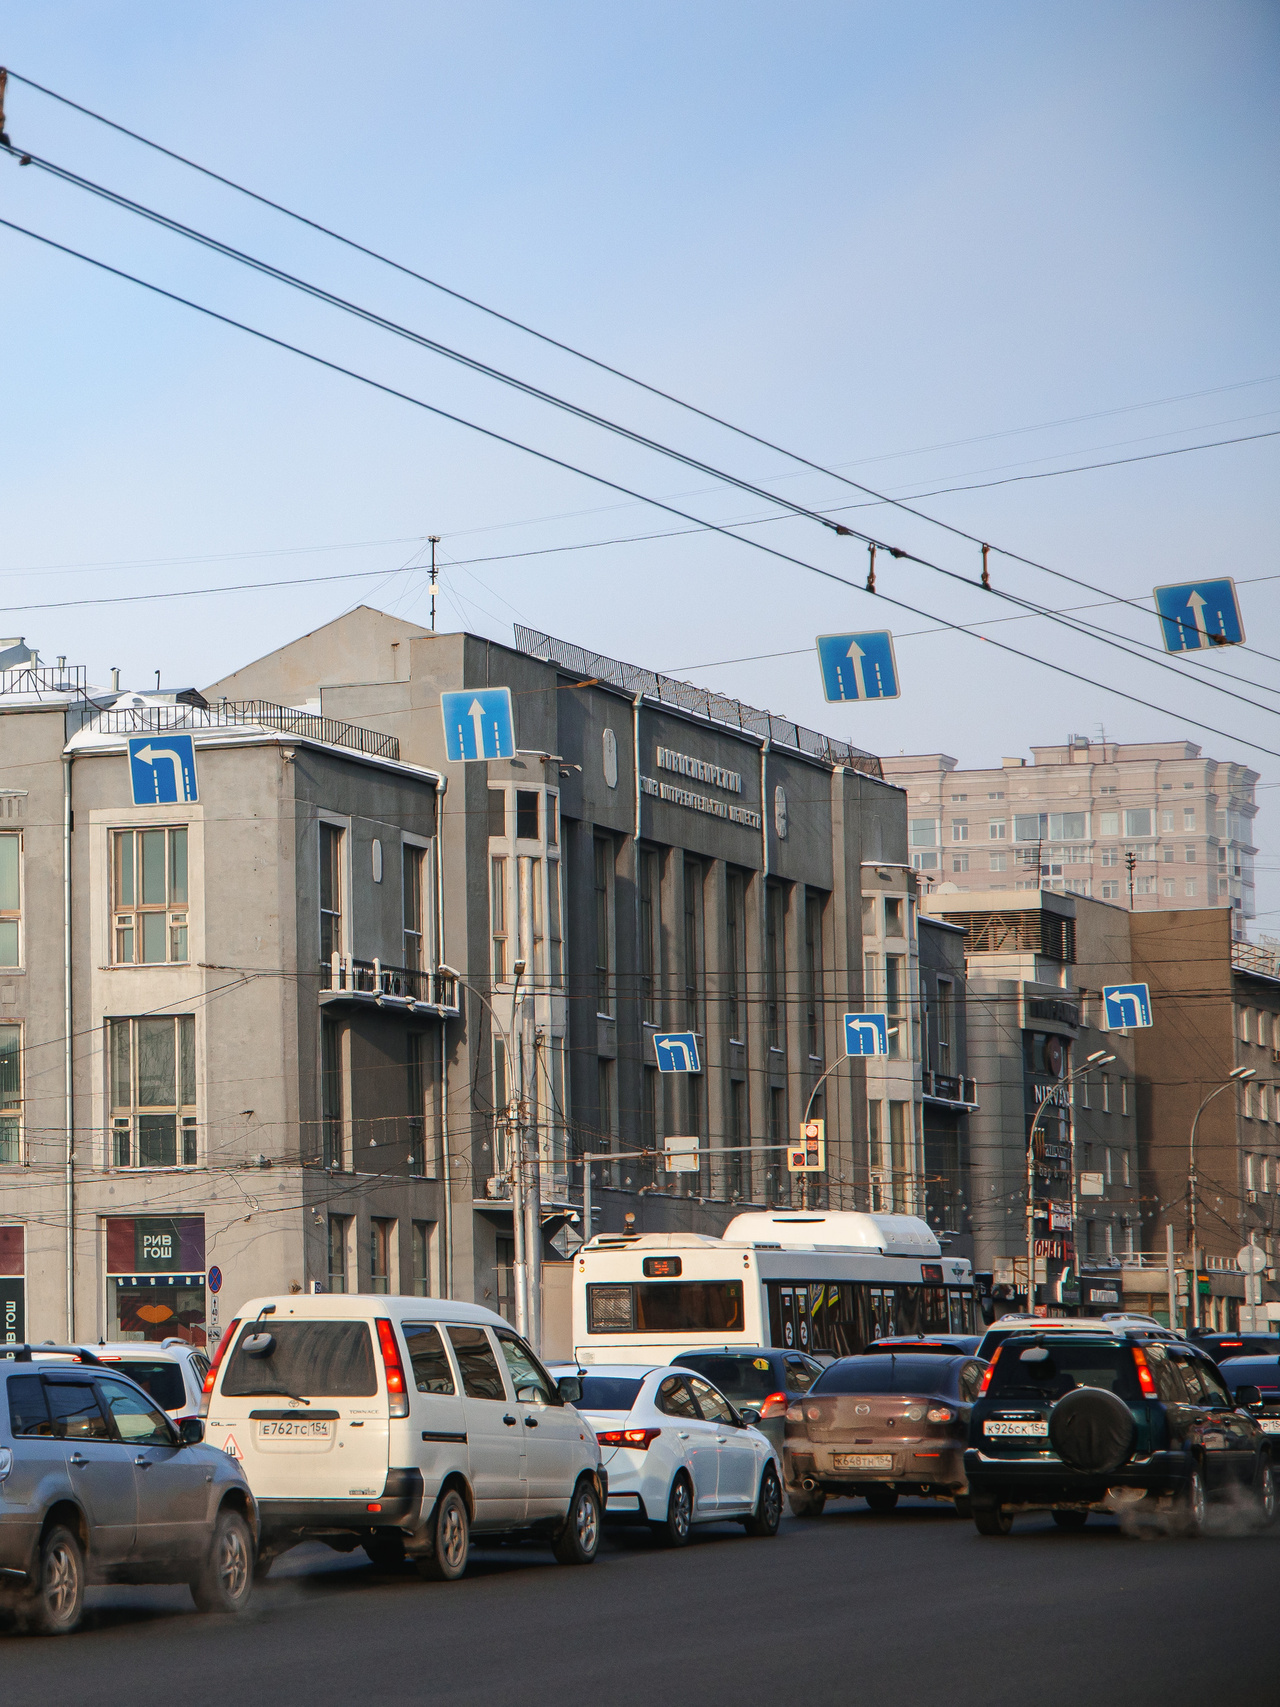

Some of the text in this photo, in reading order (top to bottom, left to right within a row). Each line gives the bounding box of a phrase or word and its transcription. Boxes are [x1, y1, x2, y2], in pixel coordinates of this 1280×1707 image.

[656, 745, 742, 793] НОВОСИБИРСКИЙ
[144, 1234, 172, 1246] РИВ
[144, 1246, 172, 1258] ГОШ
[6, 1301, 17, 1359] ГОШ РВ
[310, 1422, 327, 1432] 154
